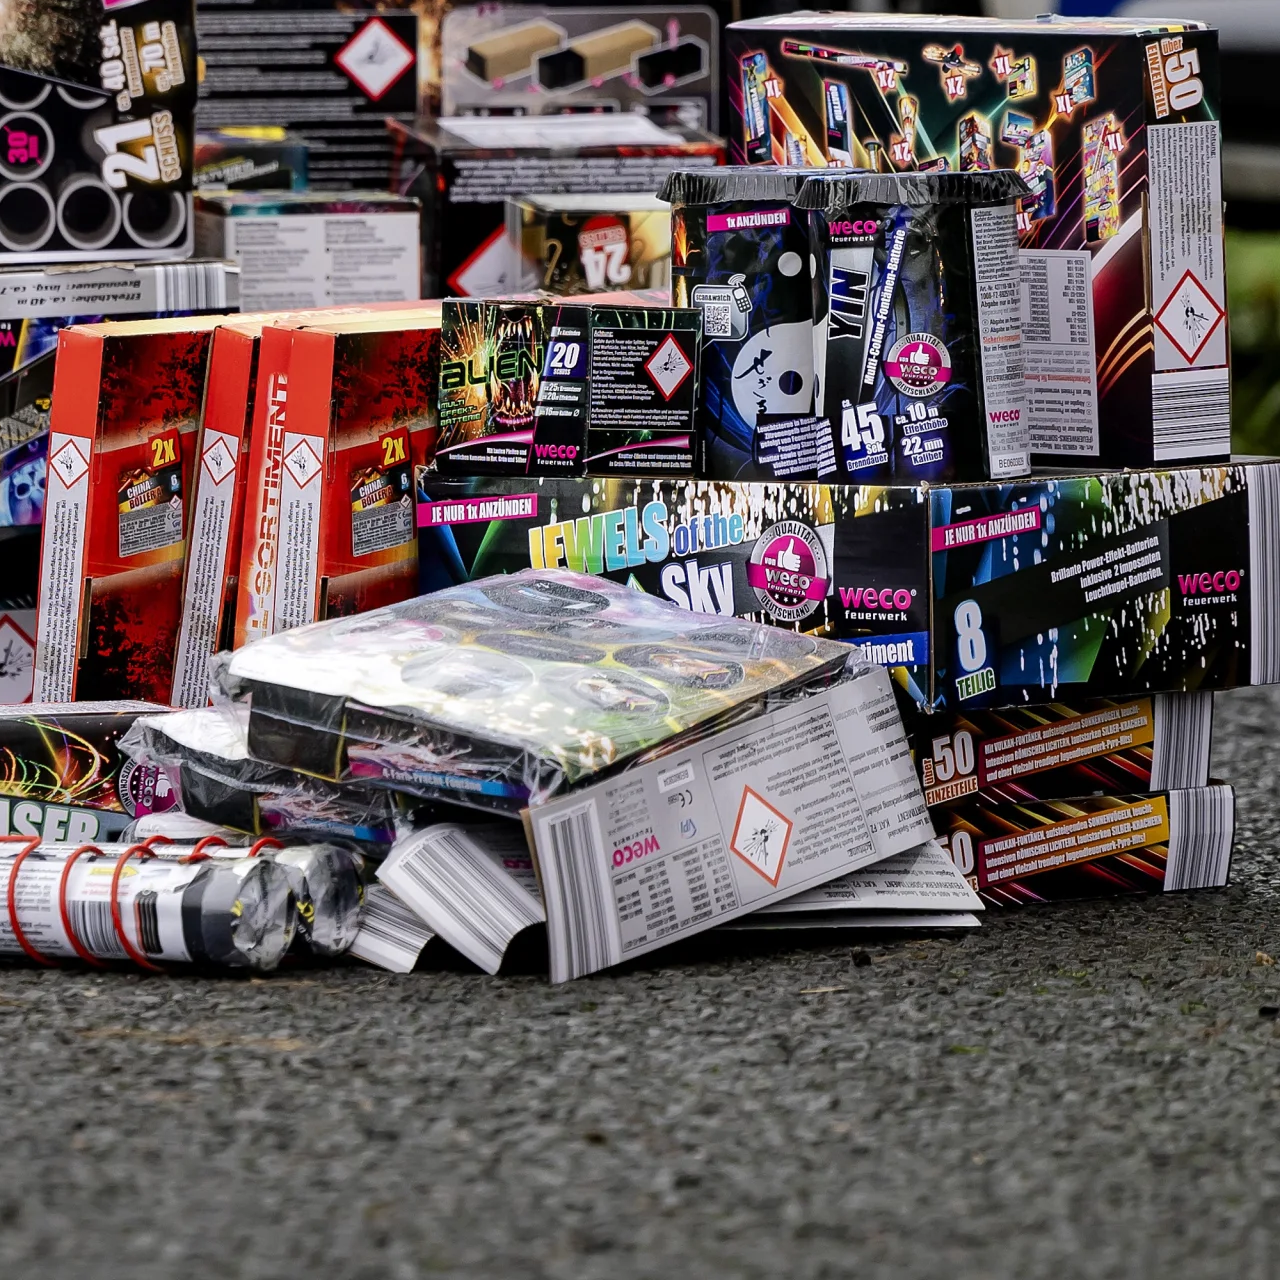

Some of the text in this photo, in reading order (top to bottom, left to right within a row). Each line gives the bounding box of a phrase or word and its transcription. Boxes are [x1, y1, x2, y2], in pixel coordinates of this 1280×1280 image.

[1161, 37, 1183, 55] über
[140, 42, 166, 74] 70
[99, 58, 126, 91] 40
[1146, 42, 1169, 119] EINZELTEILE
[1165, 48, 1203, 111] 50
[7, 131, 28, 163] 30
[93, 118, 161, 189] 21
[151, 109, 183, 183] SCHUSS
[726, 212, 786, 228] 1x ANZÜNDEN
[828, 220, 877, 235] weco
[581, 241, 631, 289] 24
[66, 279, 141, 290] Brenndauer:
[31, 297, 45, 306] 40
[71, 292, 141, 302] Effekthöhe:
[828, 267, 869, 340] YIN
[864, 230, 906, 385] Multi-Colour-Fontänen-Batterie
[906, 334, 940, 347] QUALITÄT
[550, 342, 580, 368] 20
[900, 364, 938, 376] weco
[897, 381, 938, 395] DEUTSCHLAND
[440, 399, 465, 409] MULTI
[440, 406, 477, 418] EFFEKT-
[896, 402, 938, 424] ca. 10 m
[440, 414, 481, 427] BATTERIE
[841, 399, 885, 452] ca. 45
[903, 418, 948, 435] Effekthöhe
[989, 409, 1020, 423] weco
[535, 444, 577, 459] weco
[866, 442, 885, 455] Sek.
[902, 437, 943, 456] 22 mm
[912, 450, 943, 465] Kaliber
[847, 453, 888, 471] Brenndauer
[127, 481, 153, 498] CHINA-
[170, 474, 178, 486] 6
[359, 479, 384, 498] CHINA-
[401, 473, 408, 485] 6
[129, 491, 155, 510] BÖLLER
[361, 488, 386, 508] BÖLLER
[432, 498, 532, 523] JE NUR 1x ANZÜNDEN
[674, 517, 698, 556] of
[703, 512, 744, 551] the
[774, 523, 816, 546] QUALITÄT
[945, 511, 1036, 546] JE NUR 1x ANZÜNDEN
[1051, 535, 1159, 584] Brillante Power-Effekt-Batterien
[1114, 565, 1119, 577] 2
[1120, 550, 1161, 573] imposanten
[661, 560, 734, 617] Sky
[765, 568, 810, 589] weco
[1085, 566, 1163, 603] Leuchtkugel-Batterien.
[1178, 570, 1240, 595] weco
[767, 583, 806, 597] feuerwerk
[839, 587, 912, 610] weco
[1183, 593, 1237, 606] feuerwerk
[760, 594, 810, 620] DEUTSCHLAND
[844, 610, 908, 621] feuerwerk
[954, 598, 987, 672] 8
[956, 668, 996, 701] TEILIG
[932, 730, 975, 781] 50
[923, 758, 935, 786] über
[986, 770, 997, 782] und
[998, 767, 1012, 778] einer
[1012, 760, 1034, 774] Vielzahl
[121, 758, 138, 808] EUTSCHLAND
[143, 763, 157, 807] weco
[925, 776, 978, 807] EINZELTEILE
[877, 819, 891, 830] KAT.
[612, 835, 661, 867] weco
[847, 842, 874, 859] Achtung:
[987, 871, 999, 882] und
[1000, 867, 1015, 879] einer
[1015, 860, 1038, 875] Vielzahl
